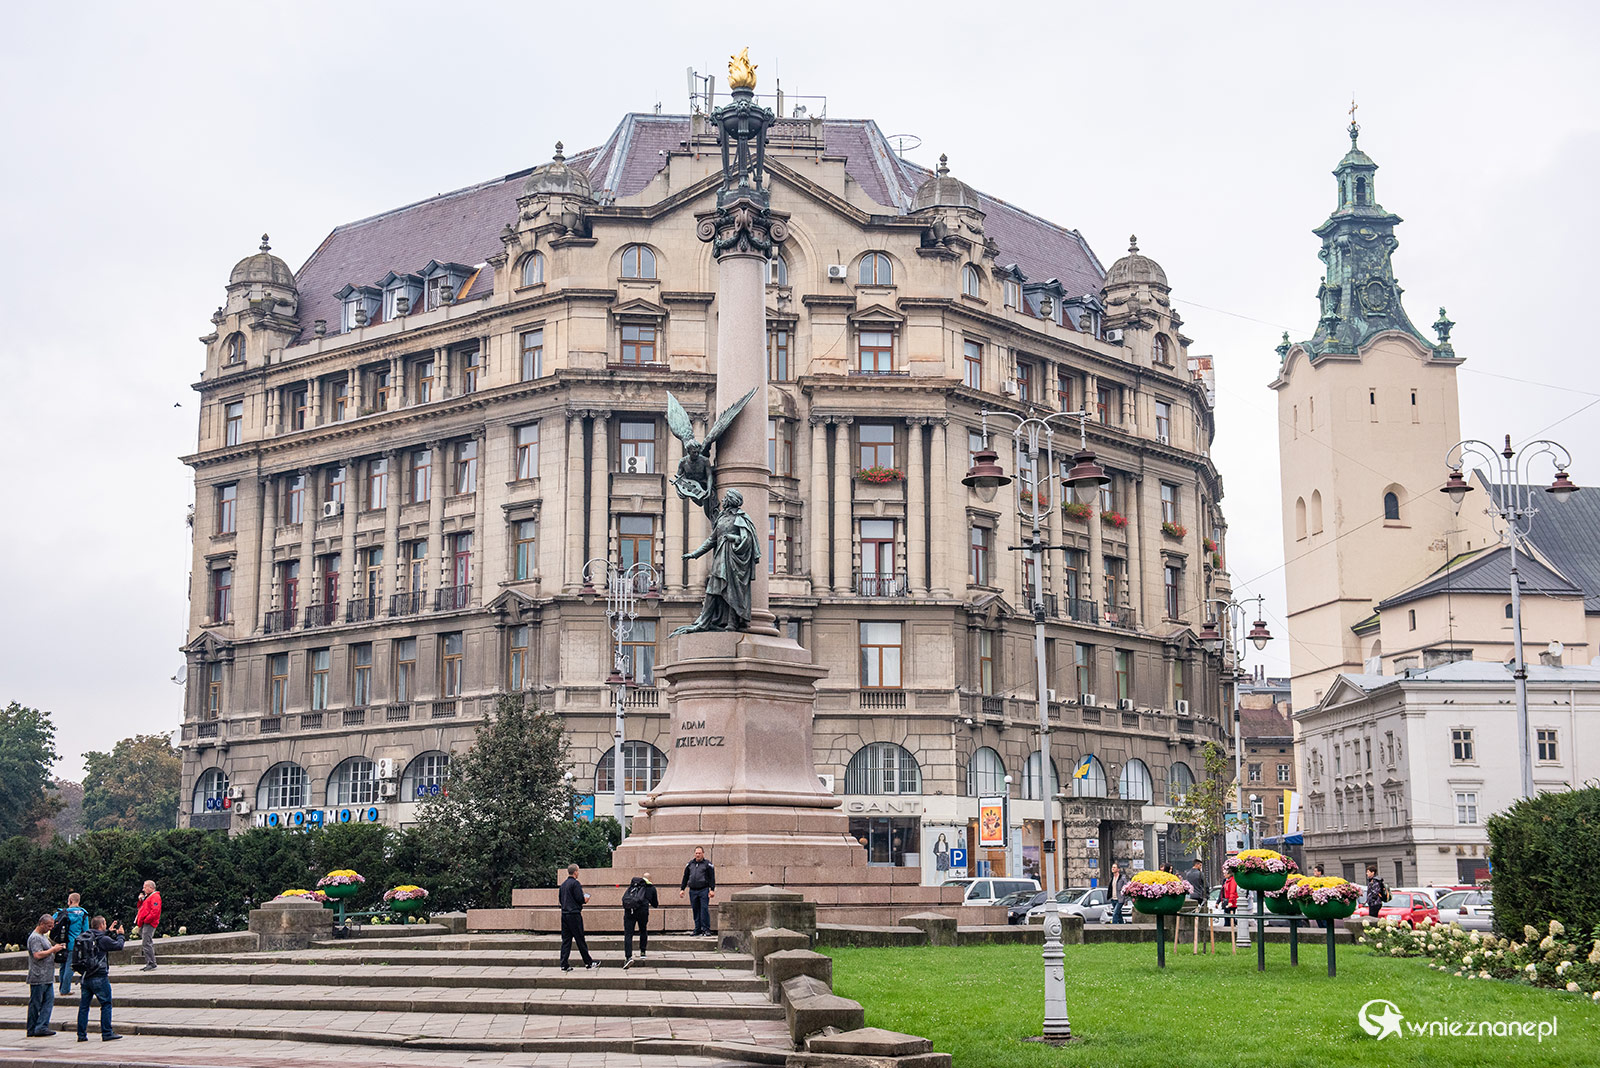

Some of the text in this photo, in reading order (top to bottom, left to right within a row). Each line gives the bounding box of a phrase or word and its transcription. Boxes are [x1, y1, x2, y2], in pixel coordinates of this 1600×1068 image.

[681, 720, 706, 730] ADAM
[848, 800, 920, 814] GANT
[256, 807, 378, 828] MOYO MOYO
[953, 850, 964, 866] P
